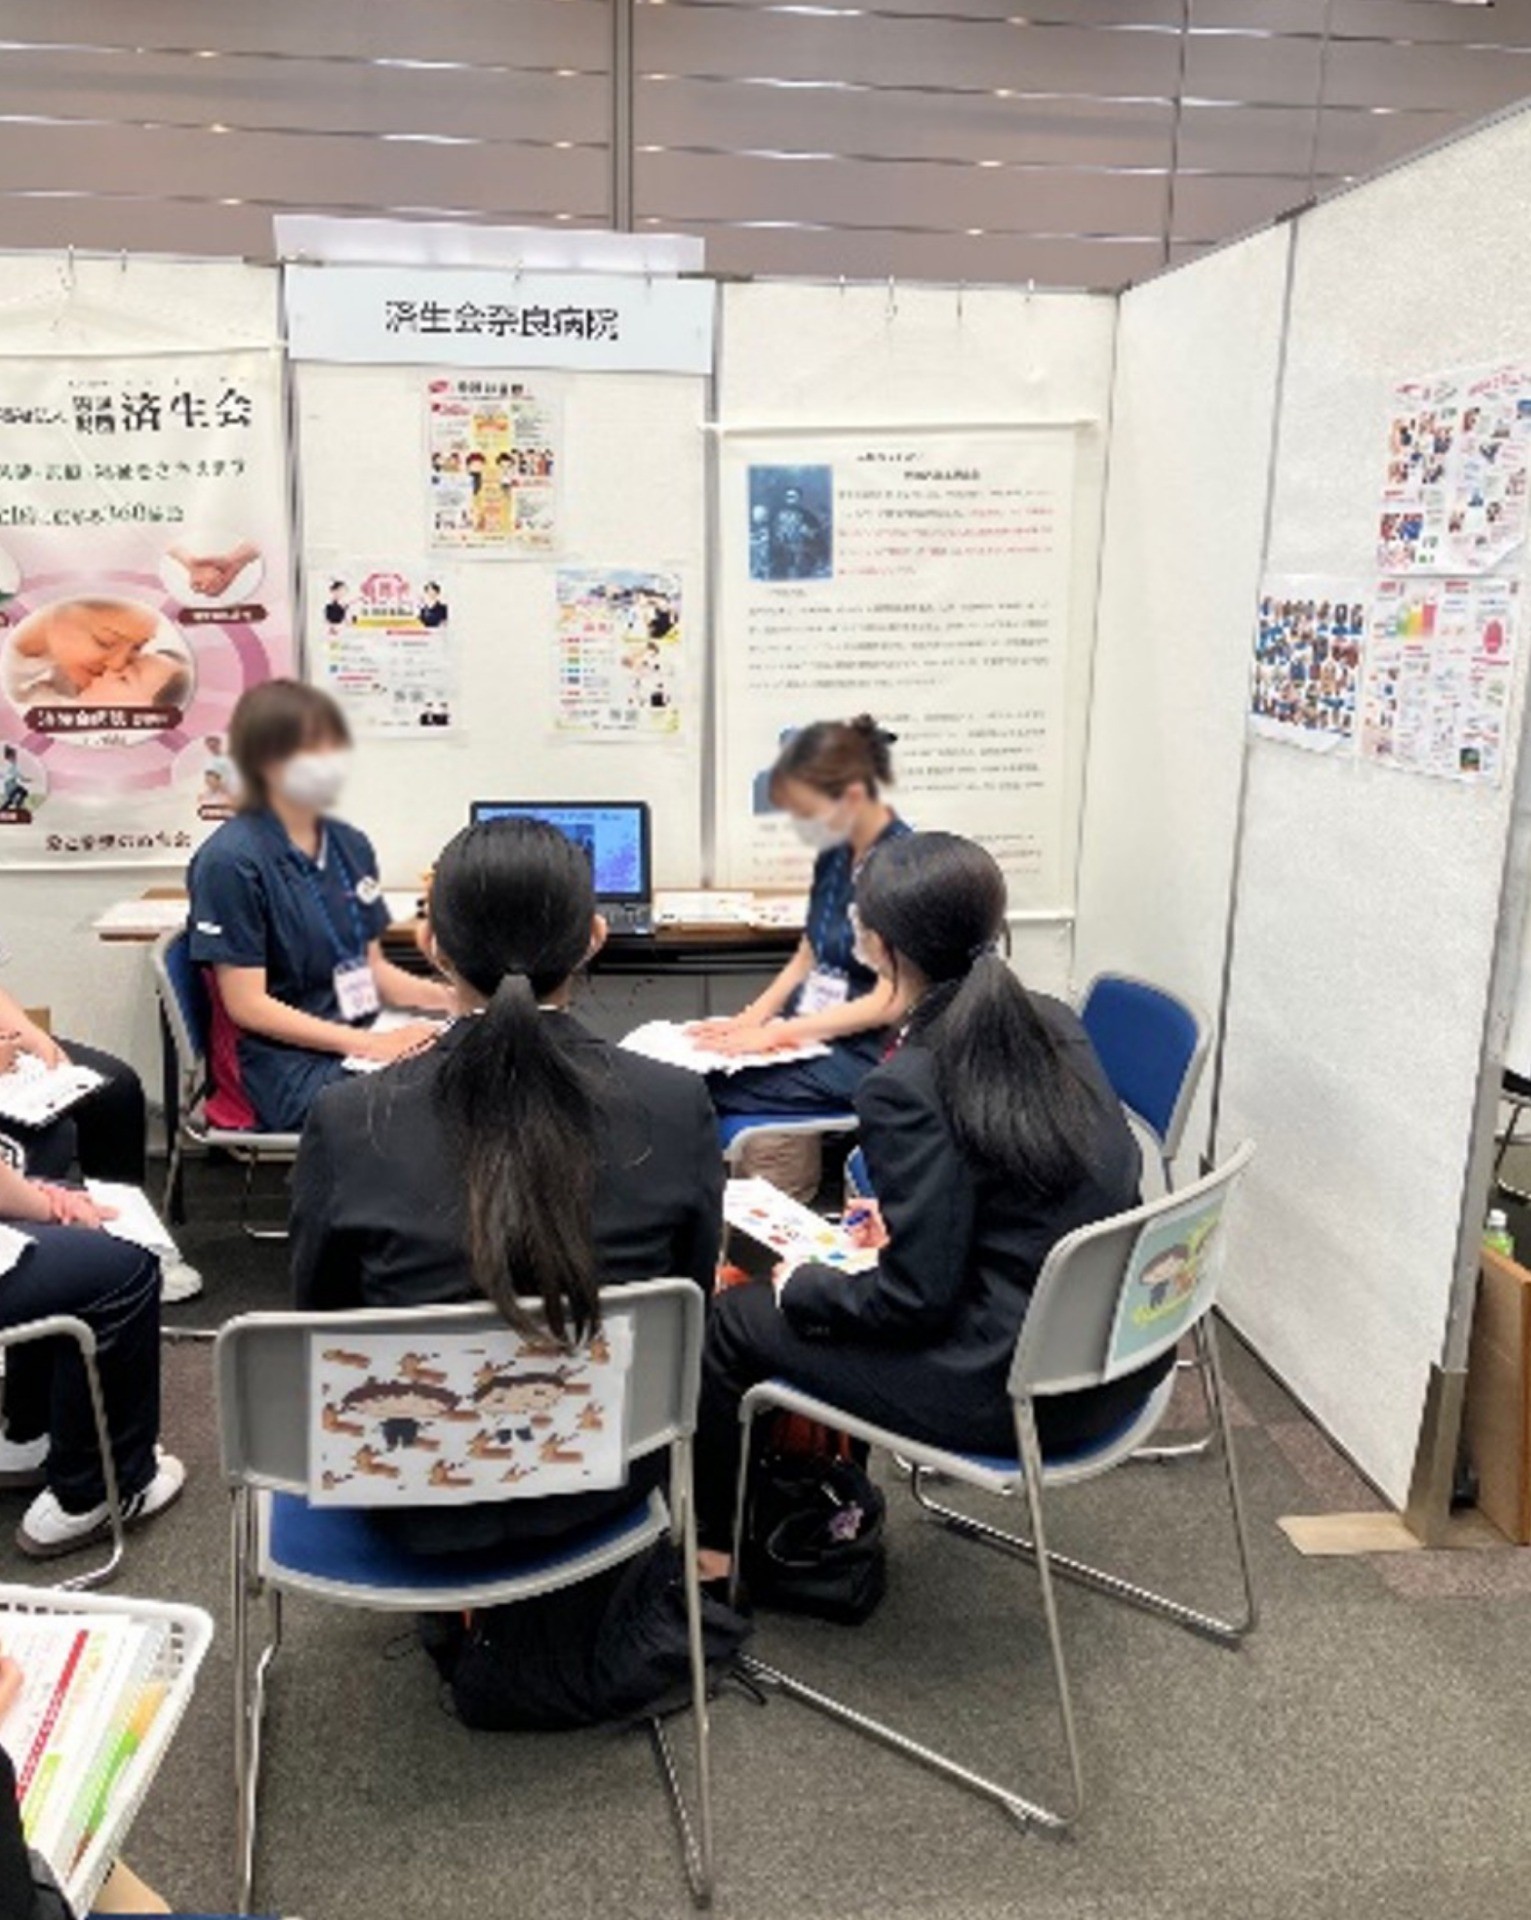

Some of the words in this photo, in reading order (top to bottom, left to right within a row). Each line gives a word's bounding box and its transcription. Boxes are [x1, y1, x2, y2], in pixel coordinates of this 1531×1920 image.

[385, 300, 619, 341] 済生会奈良病院
[121, 388, 252, 432] 済生会
